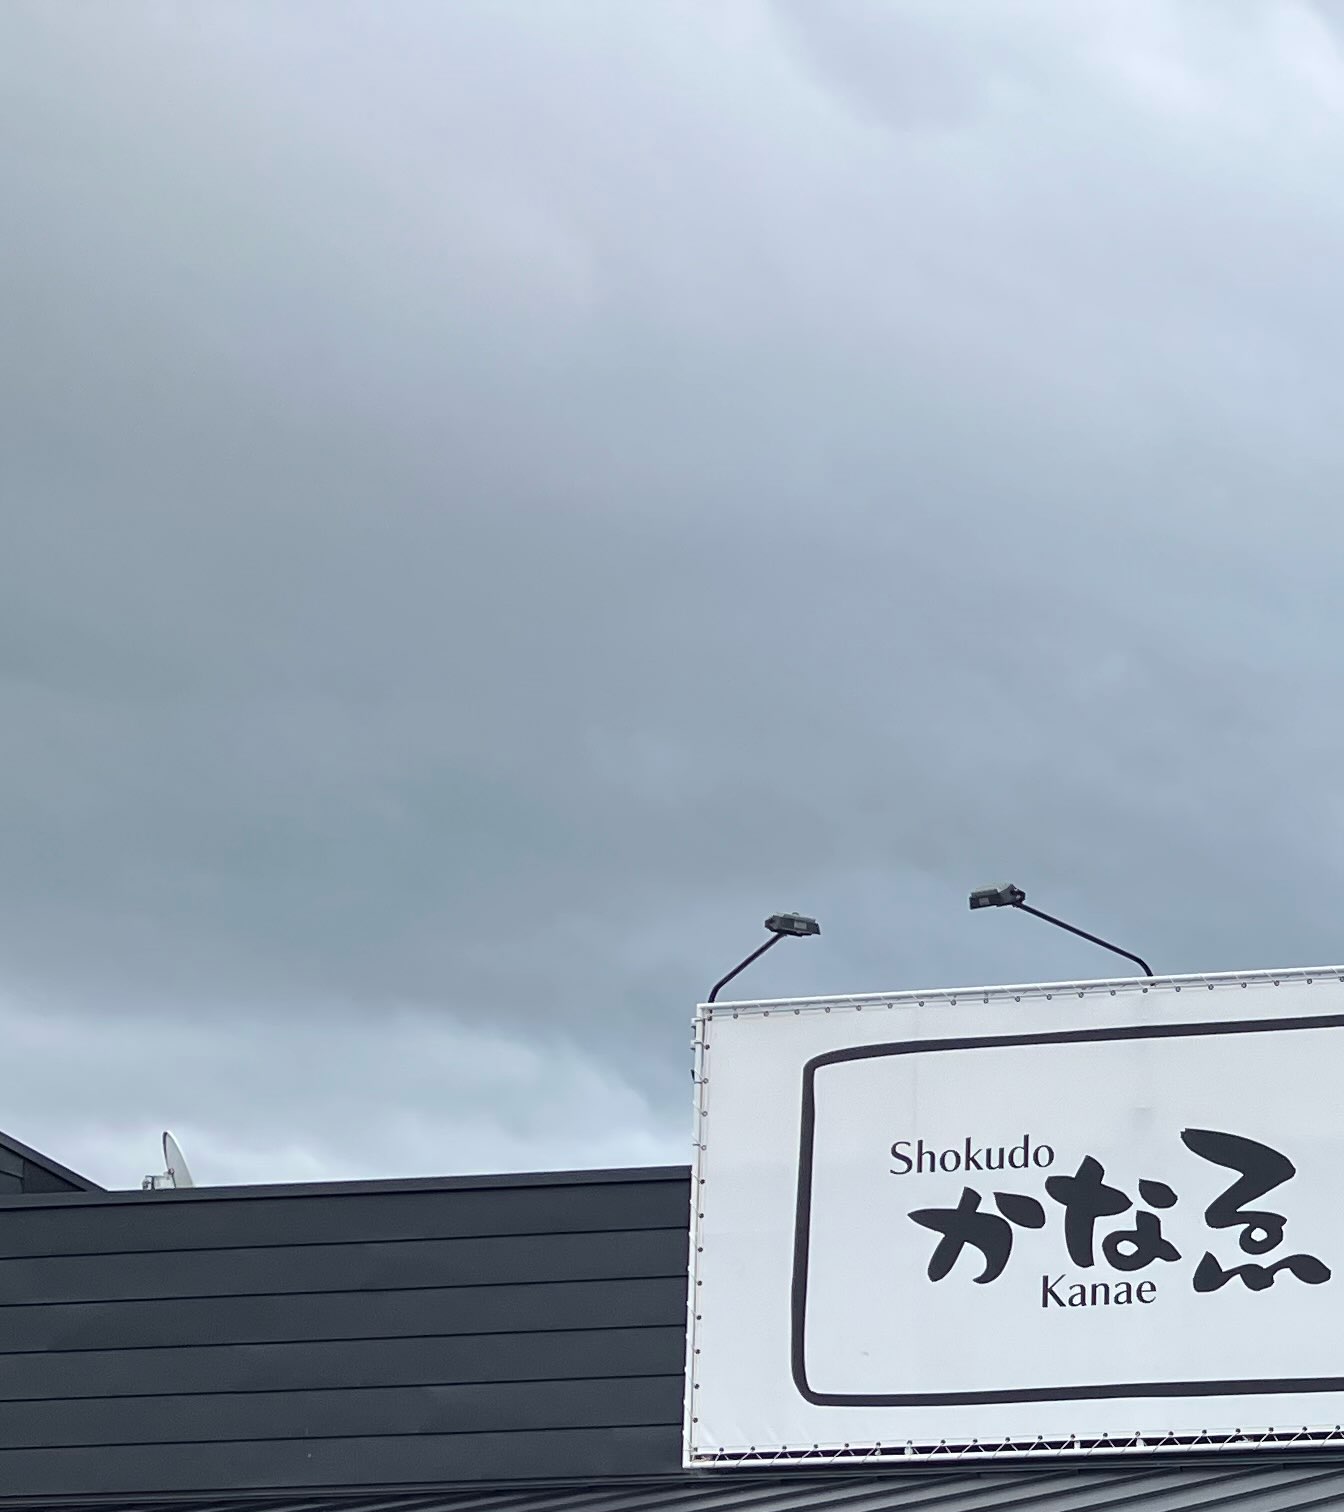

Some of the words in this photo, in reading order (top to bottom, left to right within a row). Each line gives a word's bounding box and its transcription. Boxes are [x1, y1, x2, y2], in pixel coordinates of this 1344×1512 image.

[889, 1134, 1055, 1176] Shokudo
[907, 1127, 1333, 1294] かなゑ
[1040, 1273, 1157, 1310] Kanae
